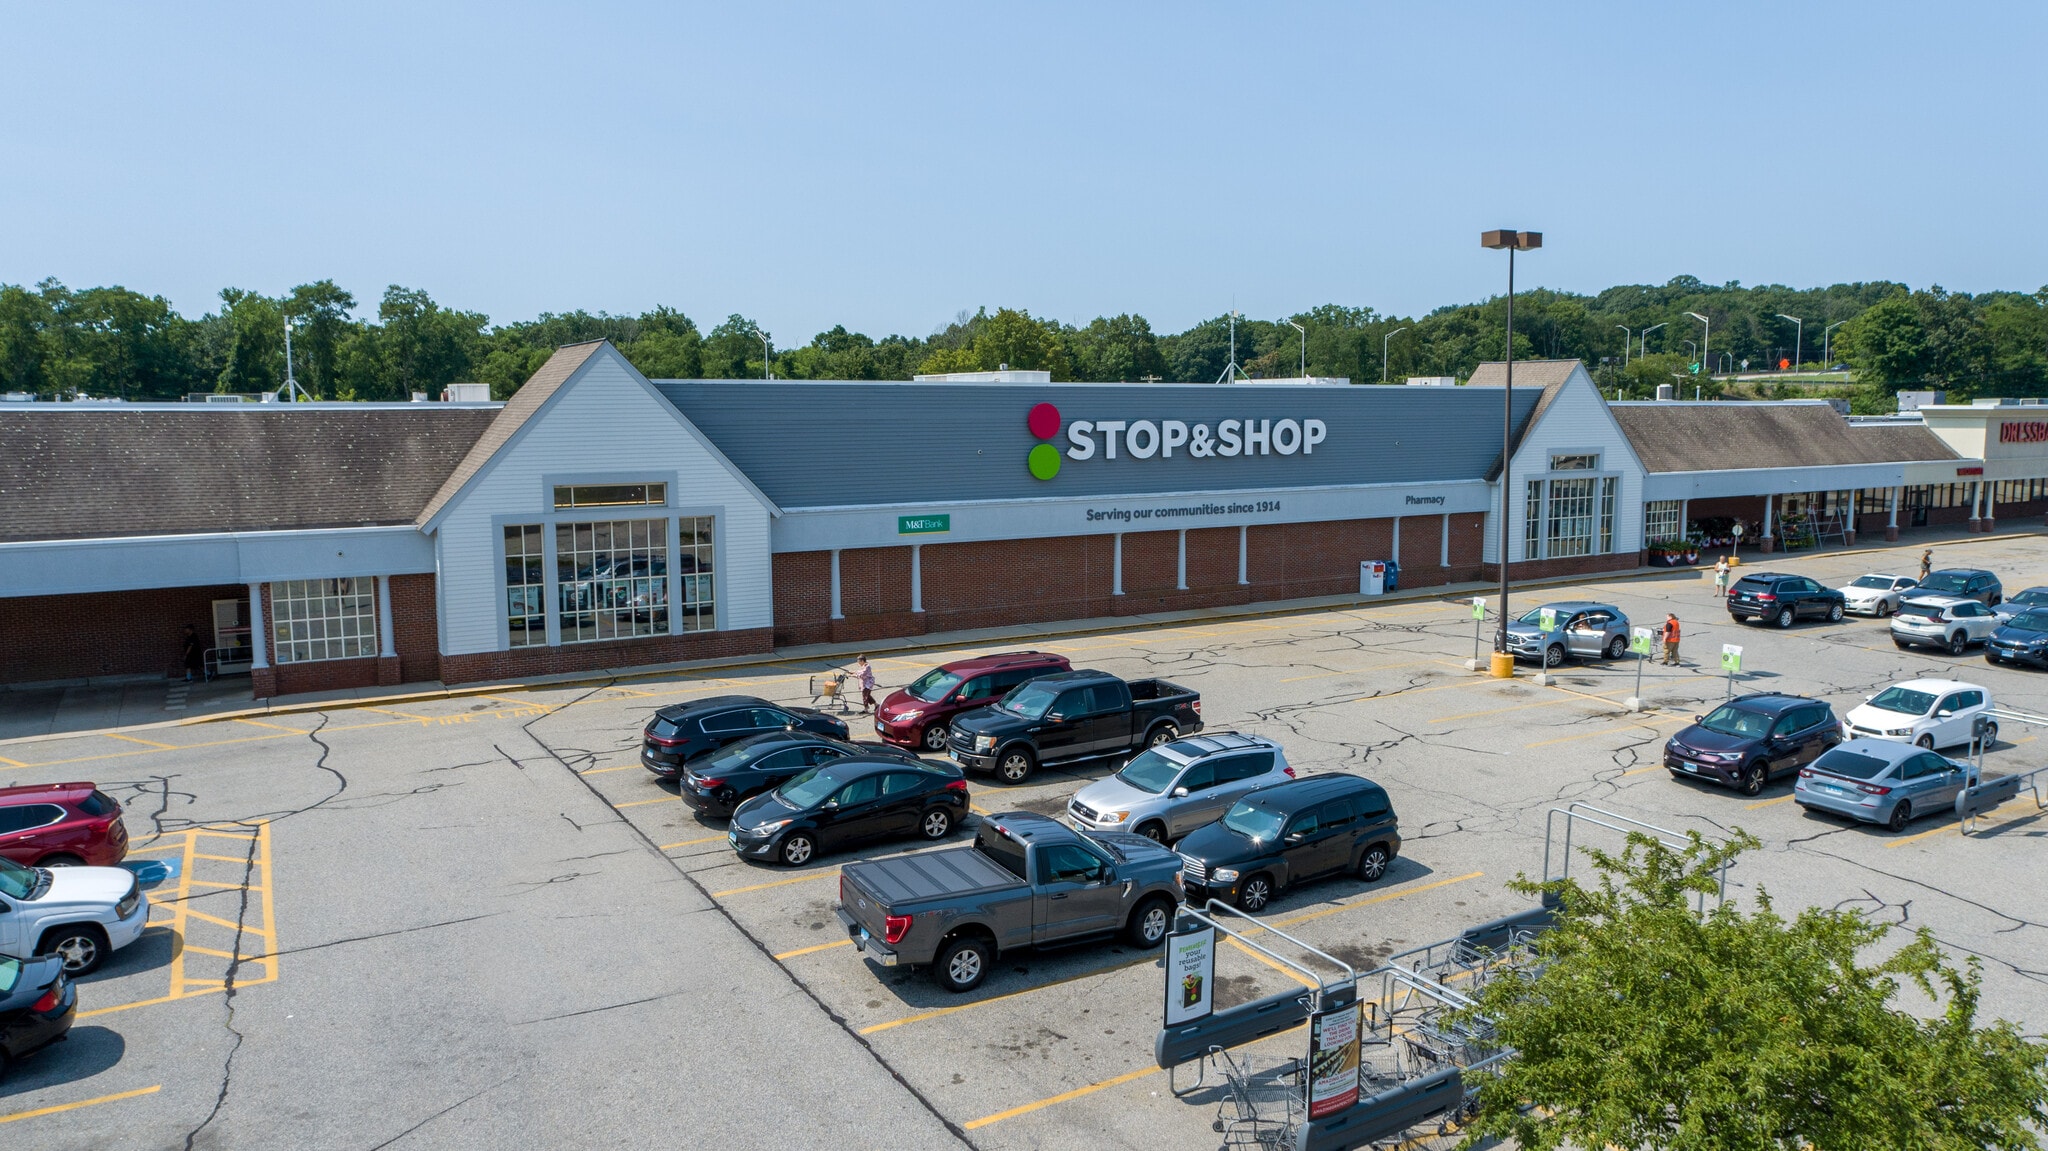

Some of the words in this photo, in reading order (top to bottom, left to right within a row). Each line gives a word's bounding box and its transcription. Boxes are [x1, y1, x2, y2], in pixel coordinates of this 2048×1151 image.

[2000, 421, 2048, 443] DRESSB
[1066, 418, 1327, 461] STOP&SHOP
[1405, 495, 1445, 506] Pharmacy
[1086, 508, 1131, 523] Serving
[1133, 508, 1153, 519] our
[1154, 503, 1226, 518] communities
[1227, 502, 1254, 514] since
[1256, 500, 1281, 513] 1914
[905, 520, 923, 530] M&T
[924, 519, 943, 529] Bank
[1178, 954, 1206, 965] reusable
[1185, 949, 1201, 959] your
